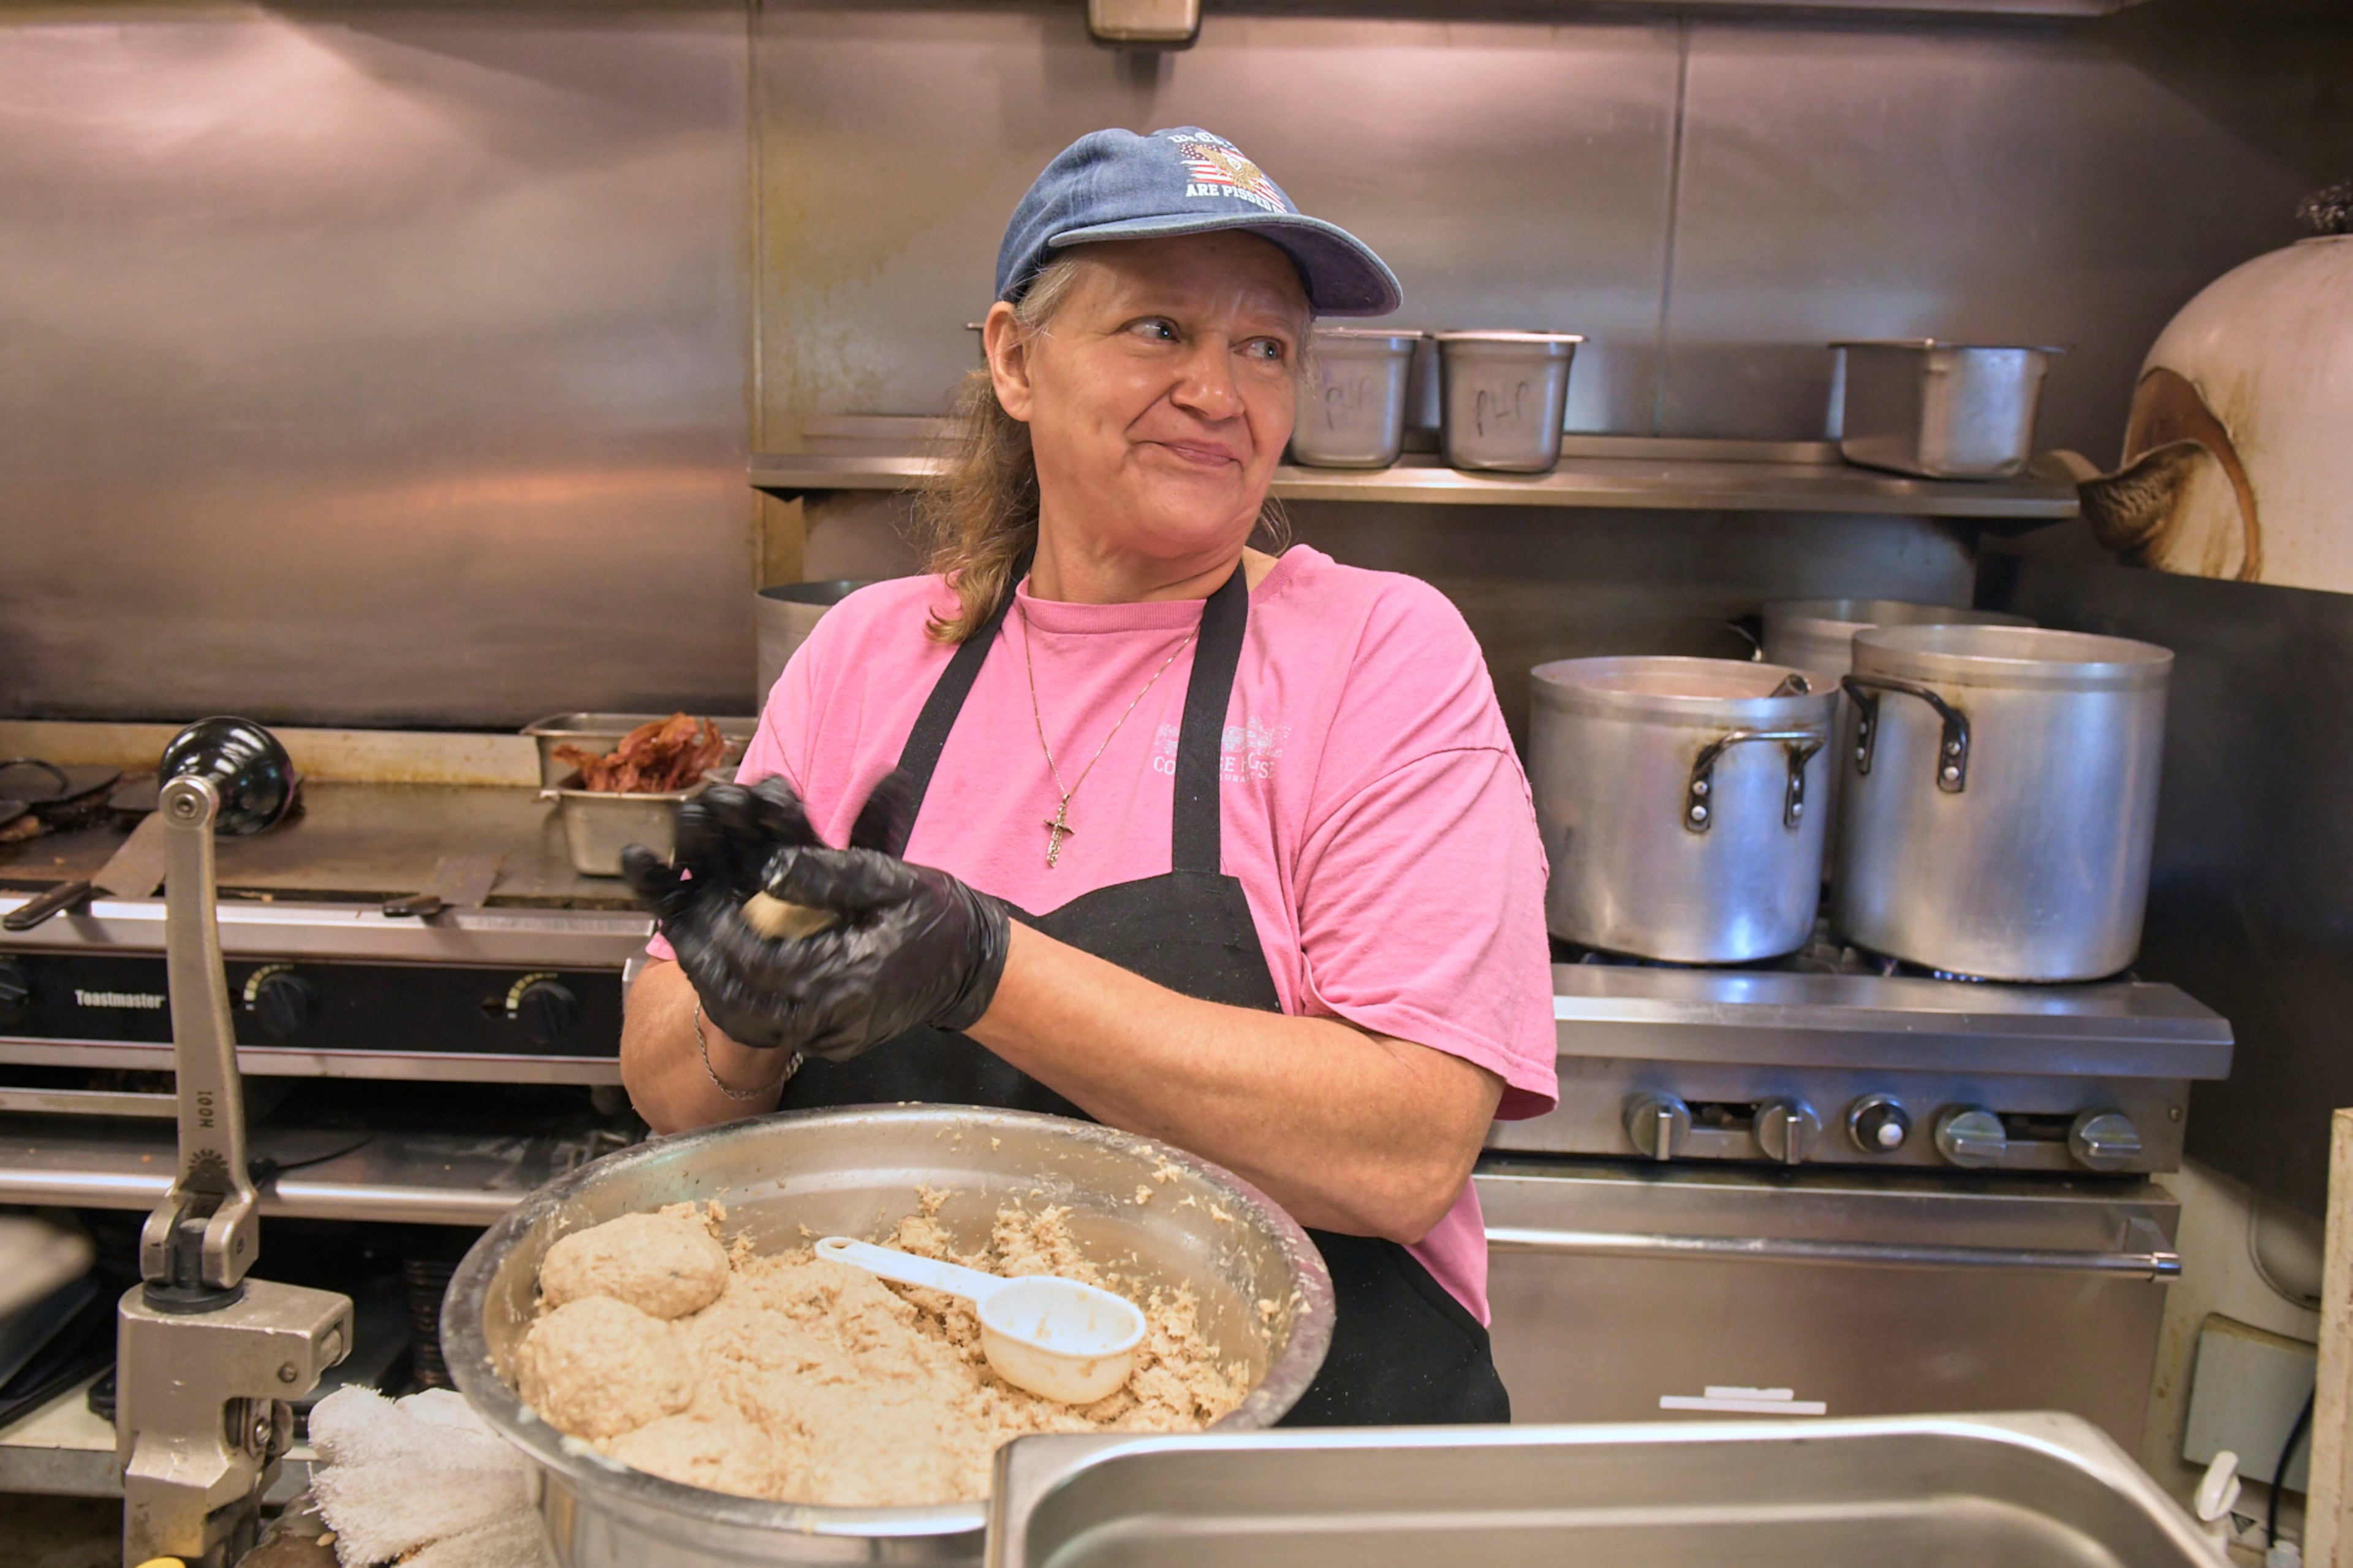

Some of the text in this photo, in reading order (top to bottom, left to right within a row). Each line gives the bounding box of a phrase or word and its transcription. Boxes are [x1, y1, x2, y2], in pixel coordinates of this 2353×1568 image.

[1186, 183, 1219, 197] ARE
[1222, 184, 1272, 211] PISSED
[74, 989, 164, 1009] Toastmaster
